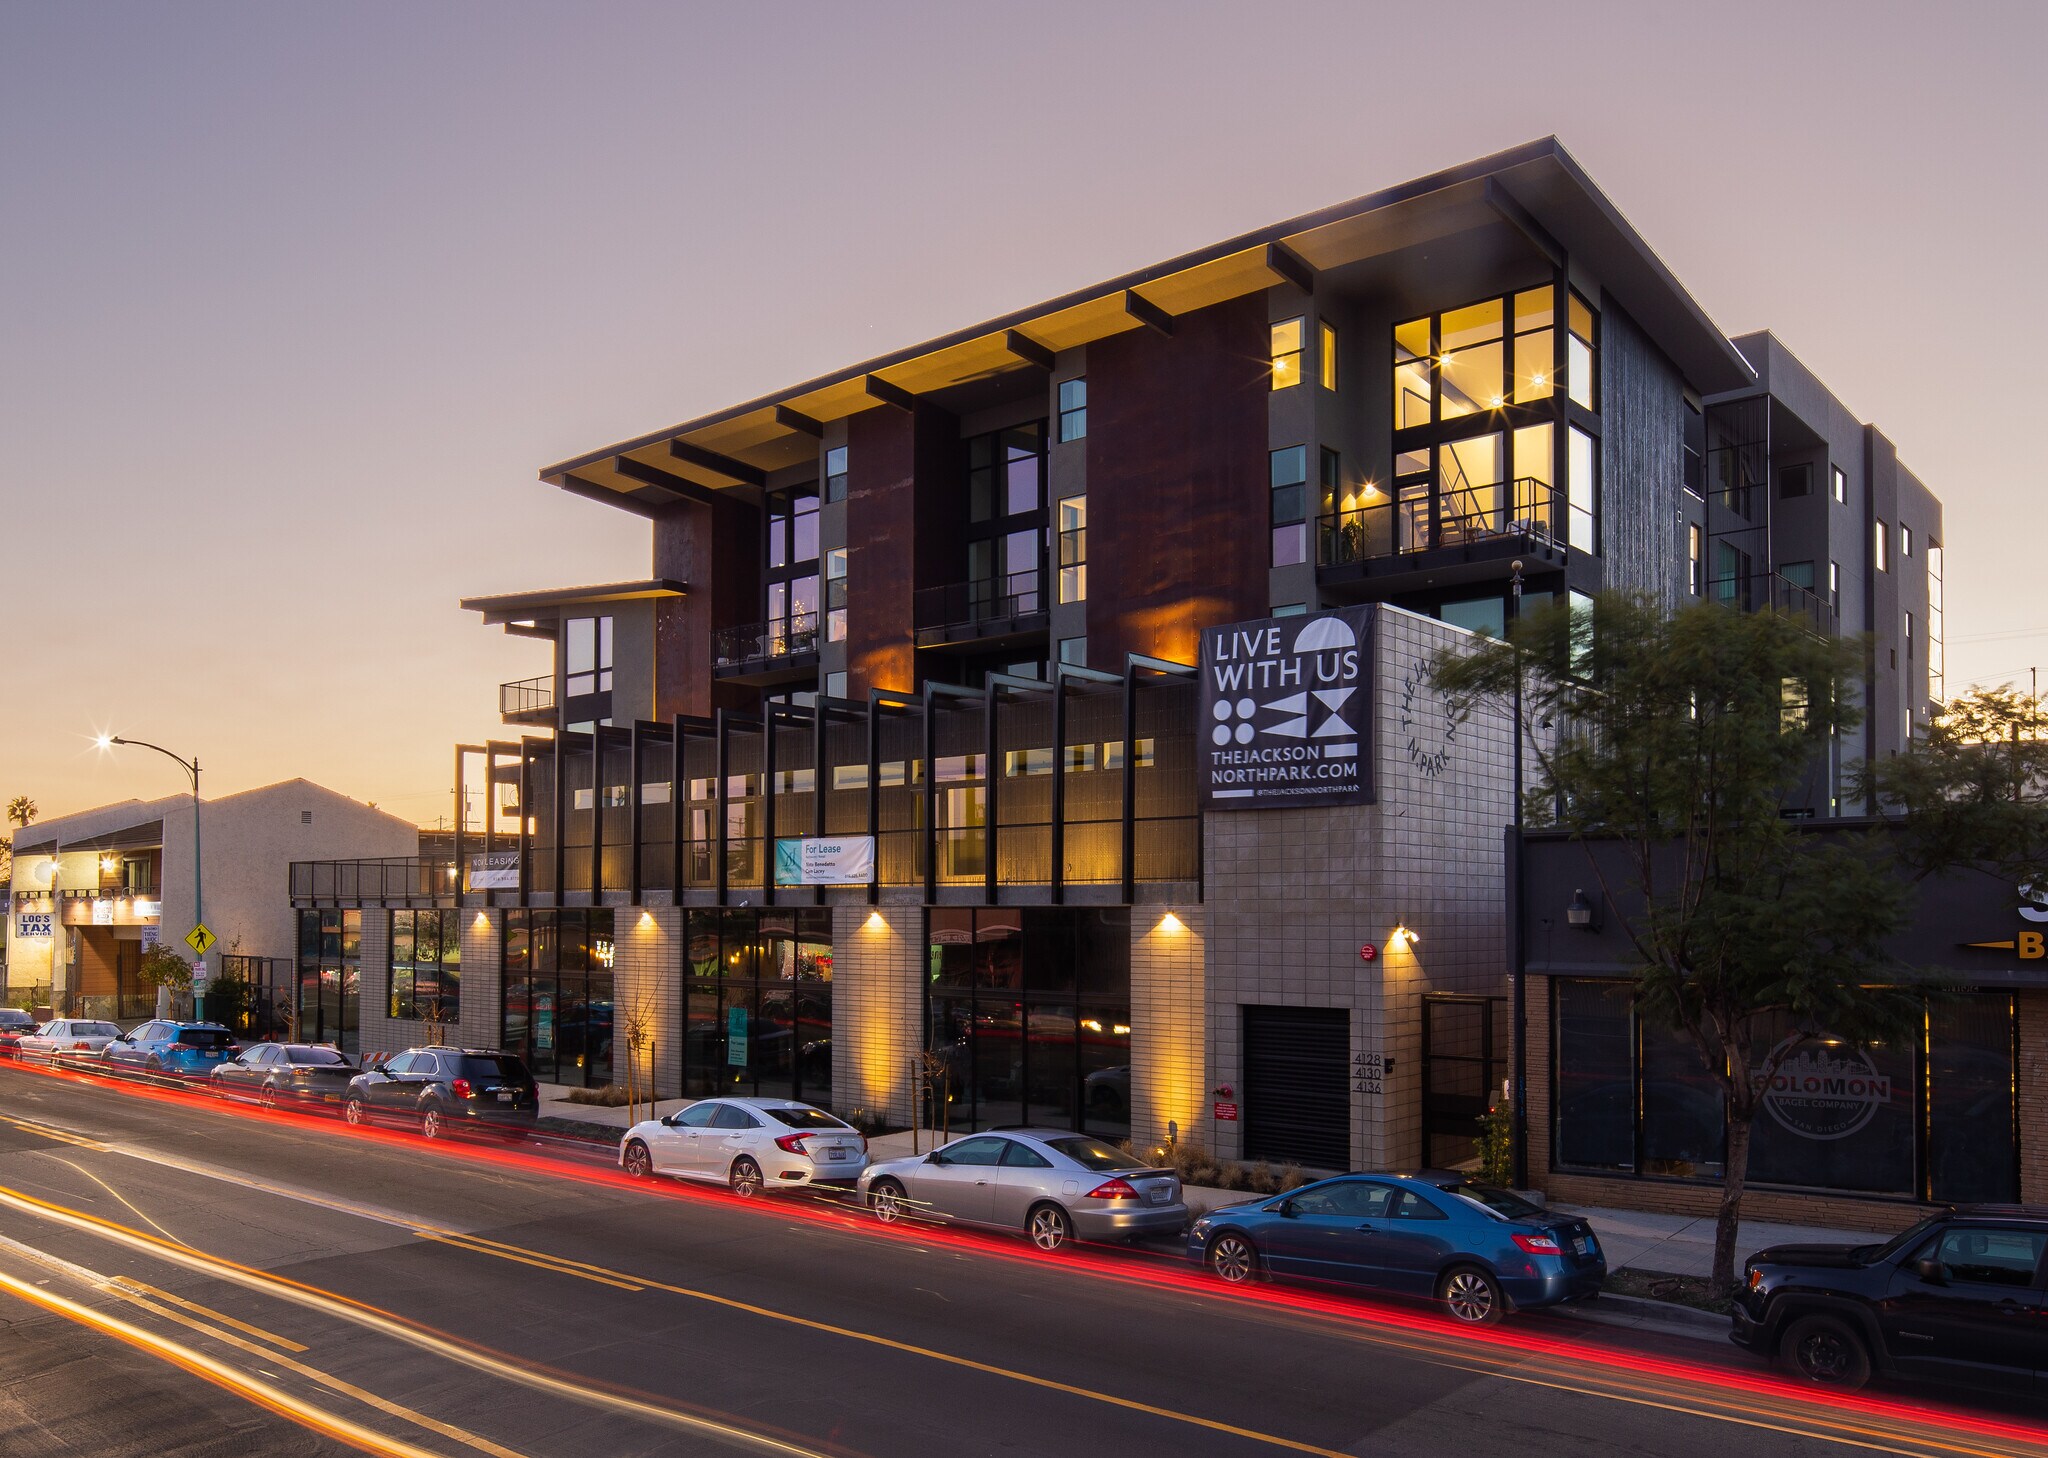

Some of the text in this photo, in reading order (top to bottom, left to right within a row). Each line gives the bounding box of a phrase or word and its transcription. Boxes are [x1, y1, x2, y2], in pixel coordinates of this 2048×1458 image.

[1216, 627, 1281, 661] LIVE
[1214, 650, 1359, 692] WITH US
[1211, 746, 1320, 765] THEJACKSON
[1211, 762, 1357, 784] NORTHPARK.COM
[805, 843, 842, 854] For Lease
[485, 856, 520, 867] LEASING
[22, 914, 51, 923] LOC'S
[20, 923, 52, 933] TAX
[1355, 1053, 1381, 1065] 4128
[1355, 1067, 1381, 1079] 4130
[1356, 1081, 1382, 1093] 4136
[1779, 1099, 1861, 1110] BAGEL COMPANY
[1817, 1121, 1847, 1133] DIEGO
